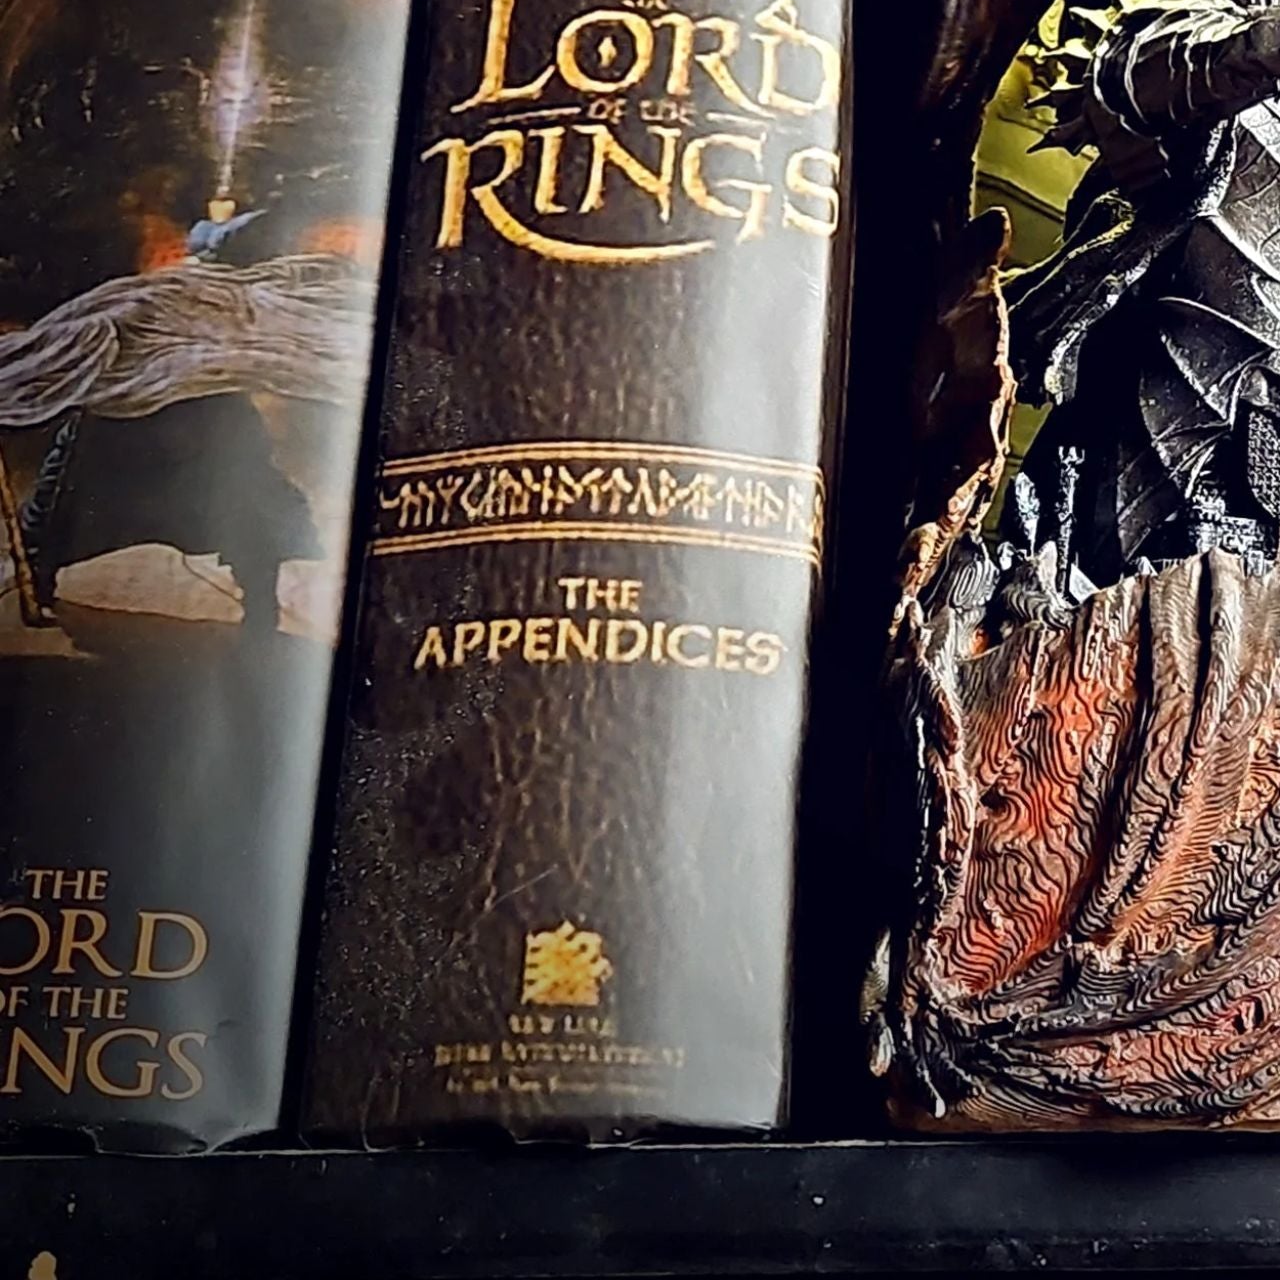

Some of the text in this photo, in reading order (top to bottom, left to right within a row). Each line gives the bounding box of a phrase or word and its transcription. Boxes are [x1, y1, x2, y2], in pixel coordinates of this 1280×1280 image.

[420, 123, 842, 266] RINGS
[559, 578, 643, 613] THE
[414, 617, 788, 676] APPENDICES
[26, 869, 109, 900] THE
[42, 985, 129, 1019] THE
